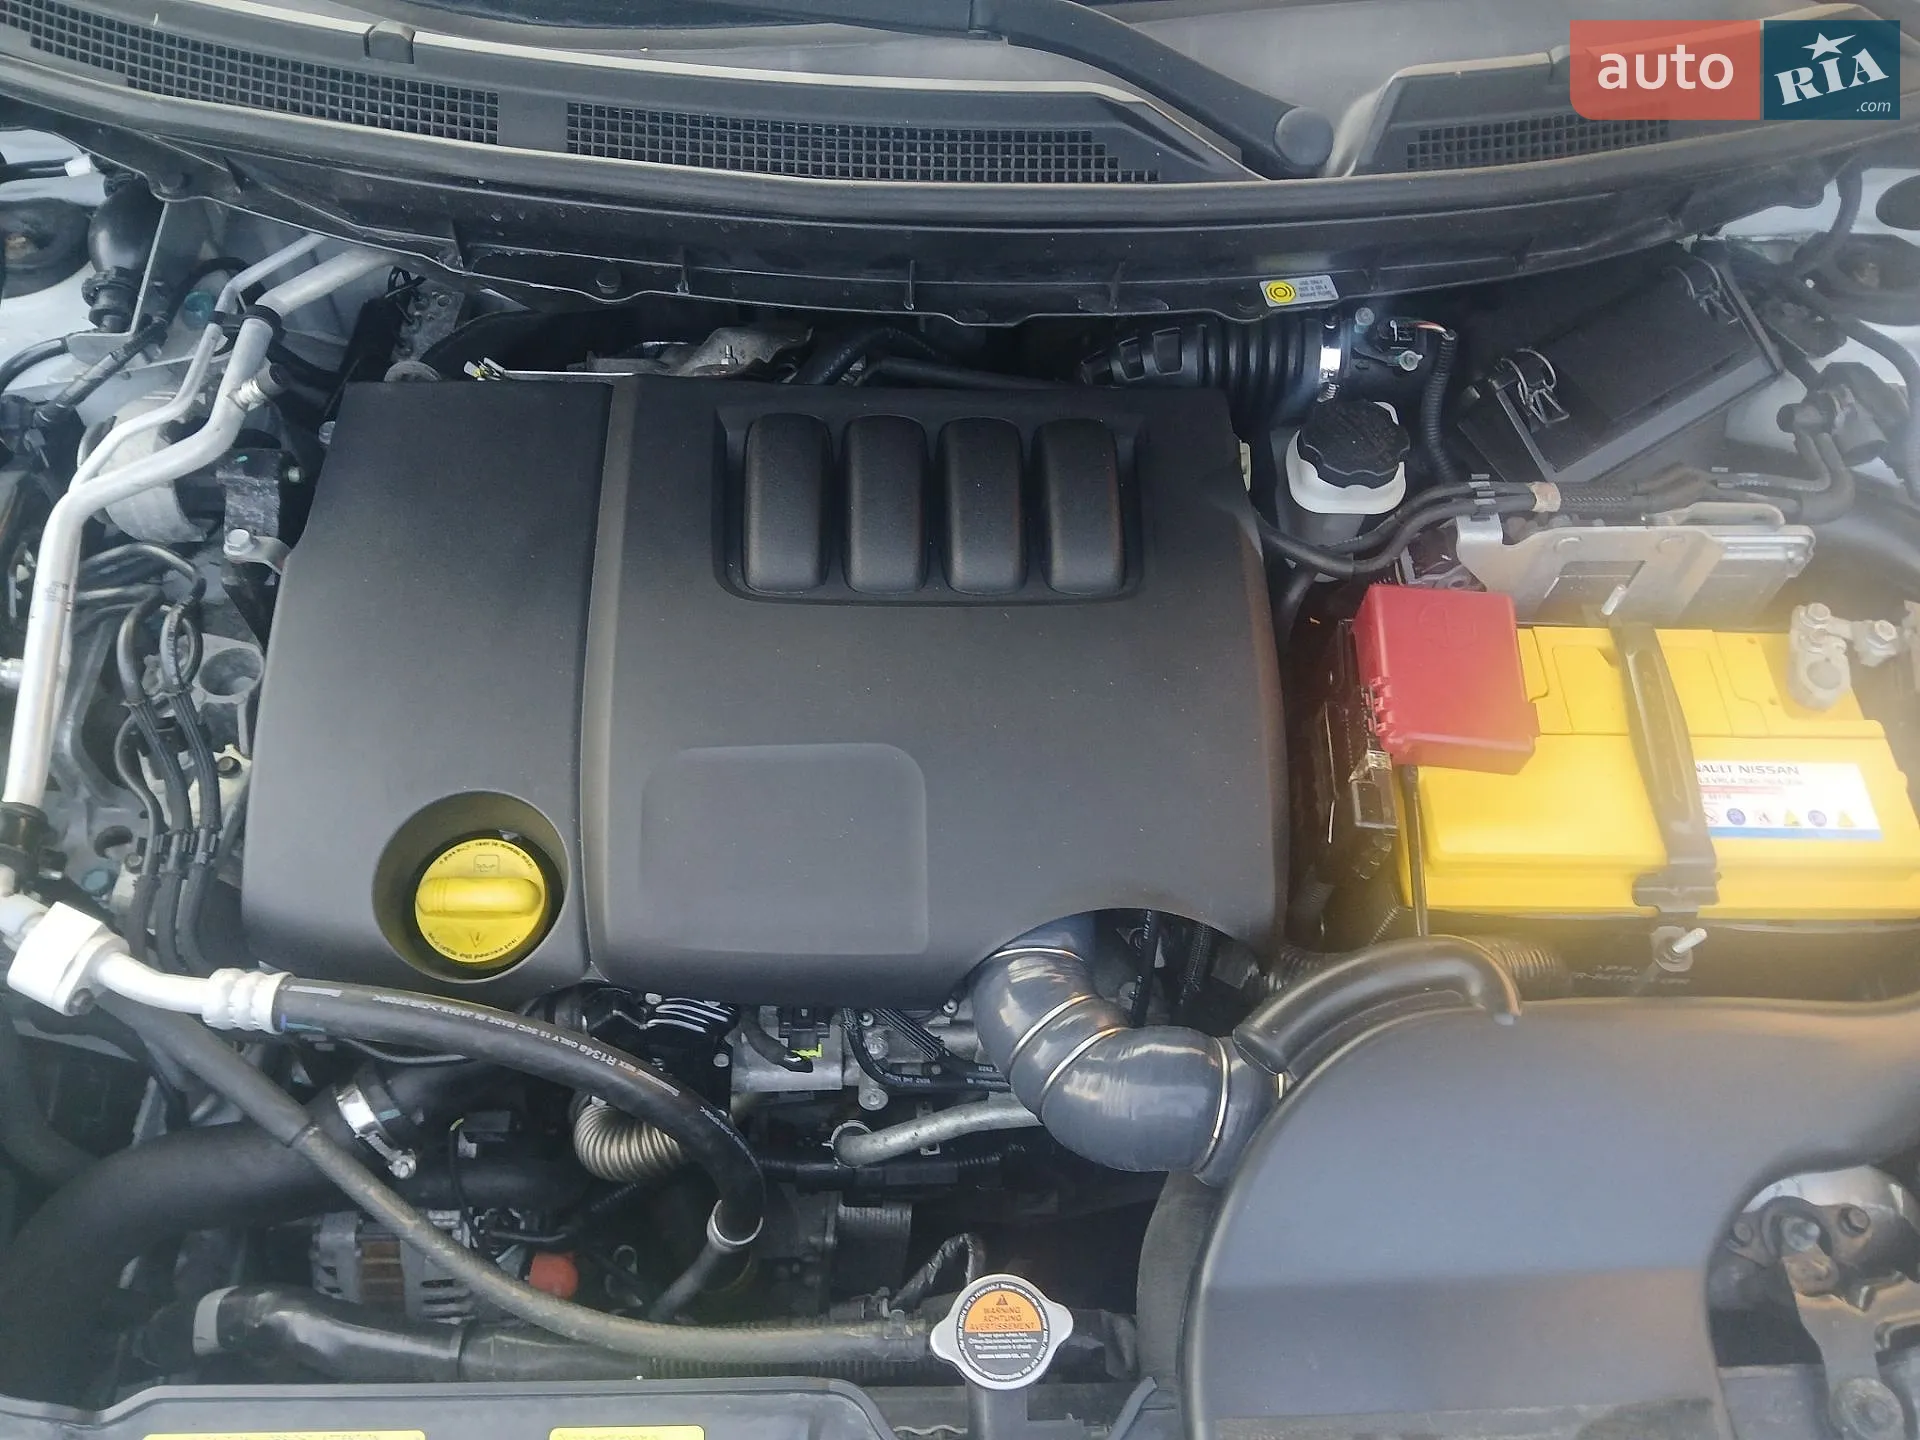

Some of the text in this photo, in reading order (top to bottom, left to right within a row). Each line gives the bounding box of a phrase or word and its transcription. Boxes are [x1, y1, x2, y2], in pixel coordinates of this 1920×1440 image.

[1739, 765, 1800, 775] NISSAN
[983, 1306, 1021, 1314] WARNING
[983, 1314, 1022, 1322] ACHTUNG
[970, 1322, 1035, 1331] AVERTISSEMENT
